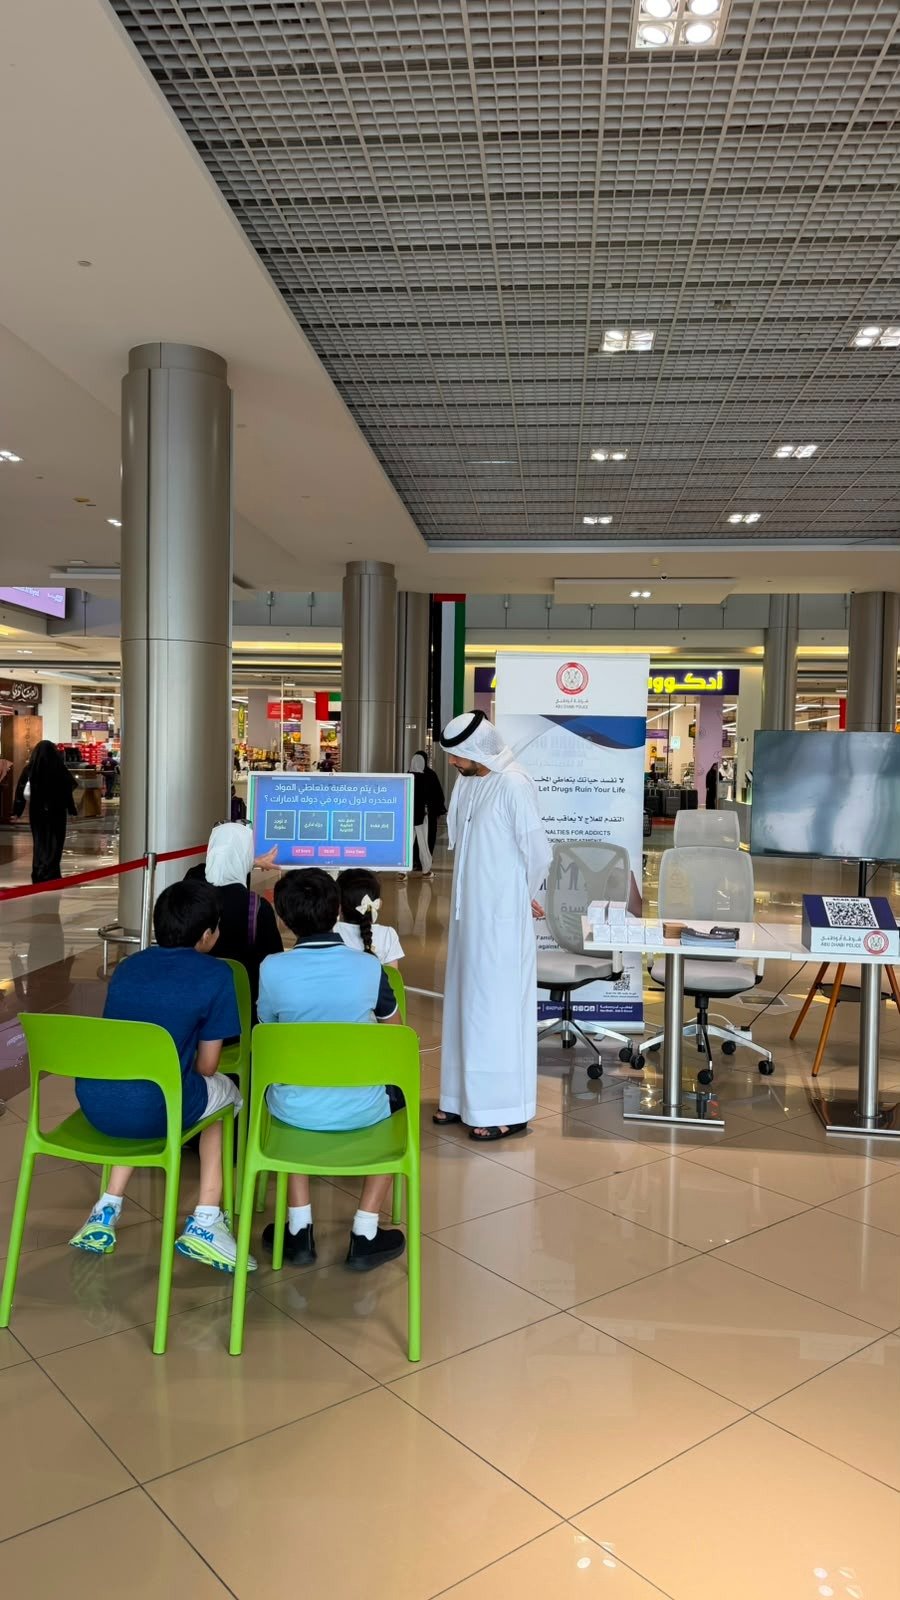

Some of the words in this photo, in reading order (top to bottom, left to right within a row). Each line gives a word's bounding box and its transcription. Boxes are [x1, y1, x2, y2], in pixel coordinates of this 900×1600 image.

[275, 784, 297, 792] المواد
[299, 783, 329, 794] متعاطي
[331, 783, 358, 792] معاقبة
[373, 784, 387, 793] هل
[551, 785, 573, 794] Drugs
[320, 796, 332, 805] في
[186, 1225, 214, 1243] HOKA
